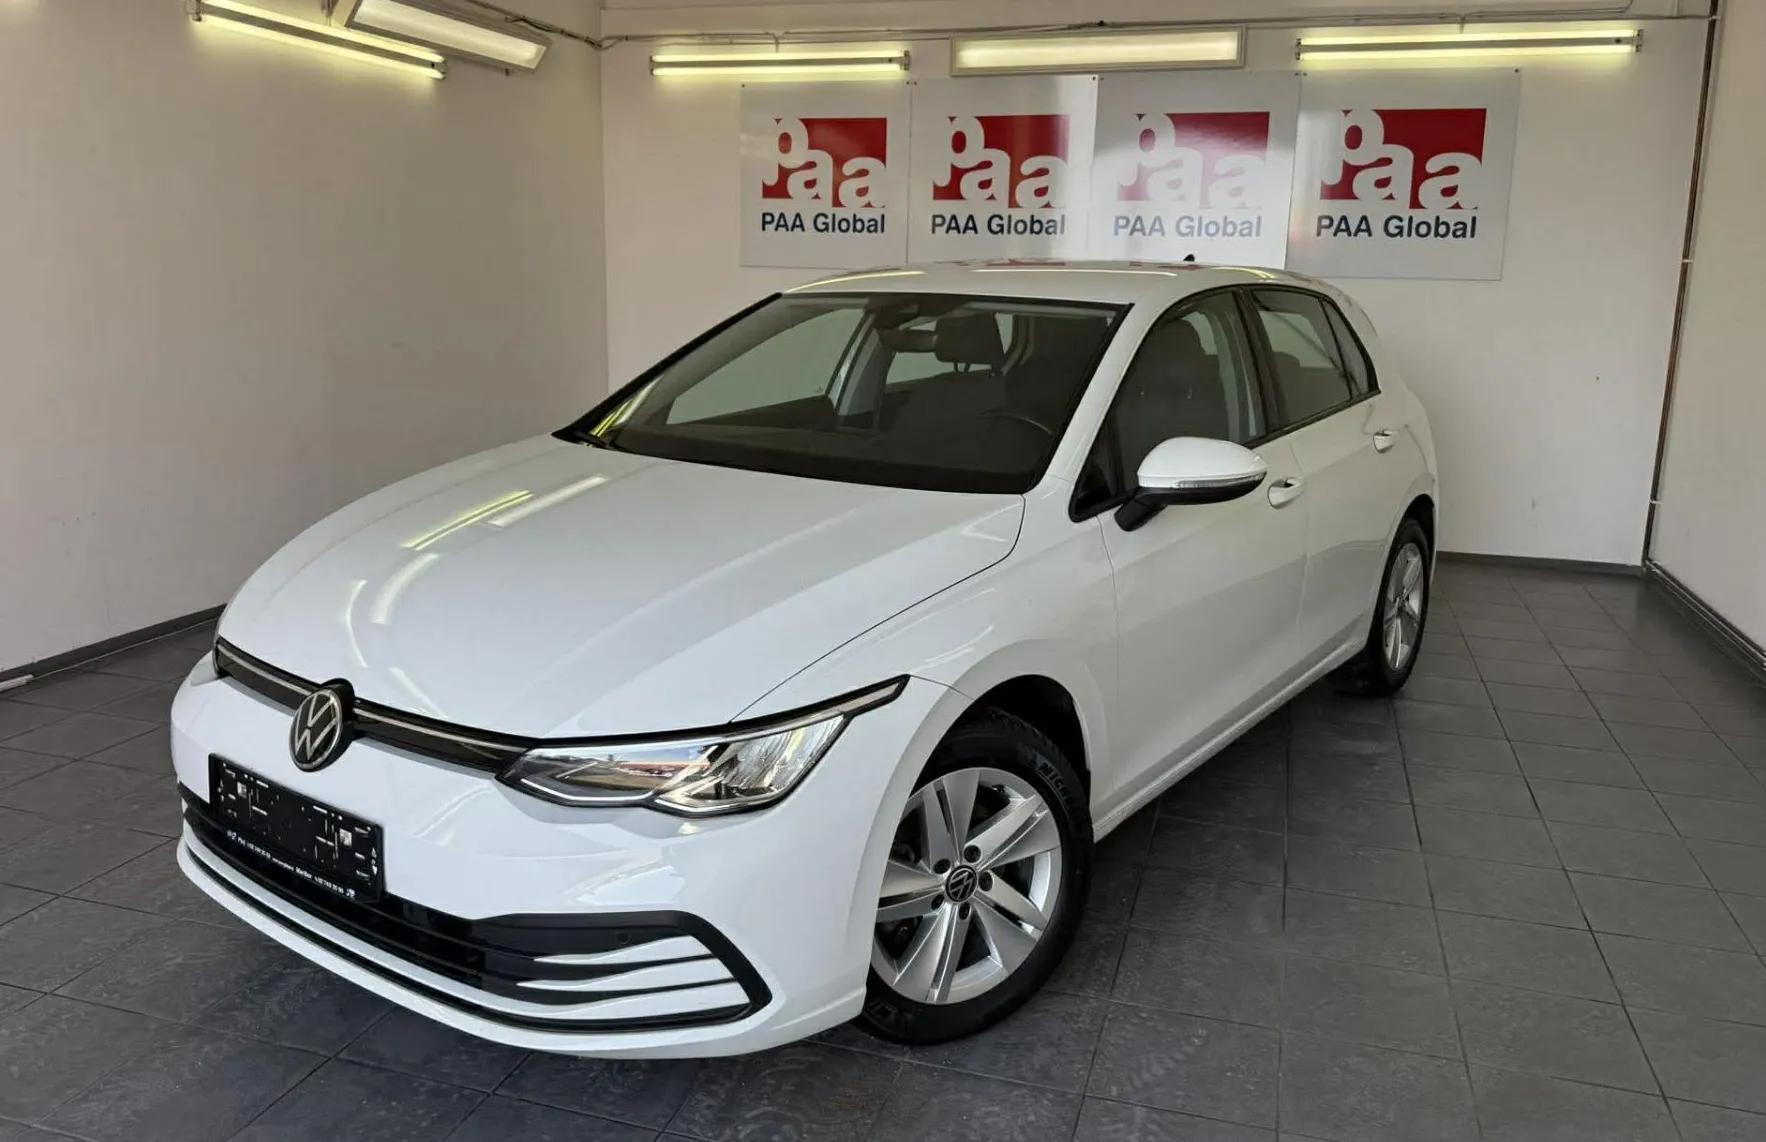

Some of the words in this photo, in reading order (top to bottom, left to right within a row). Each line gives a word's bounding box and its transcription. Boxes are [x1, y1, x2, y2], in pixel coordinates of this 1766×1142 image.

[761, 213, 805, 233] PAA
[813, 212, 885, 233] Global
[931, 215, 978, 235] PAA
[987, 214, 1065, 236] Global
[1113, 215, 1165, 237] PAA
[1175, 215, 1262, 238] Global
[1316, 215, 1373, 238] PAA
[1383, 215, 1477, 239] Global
